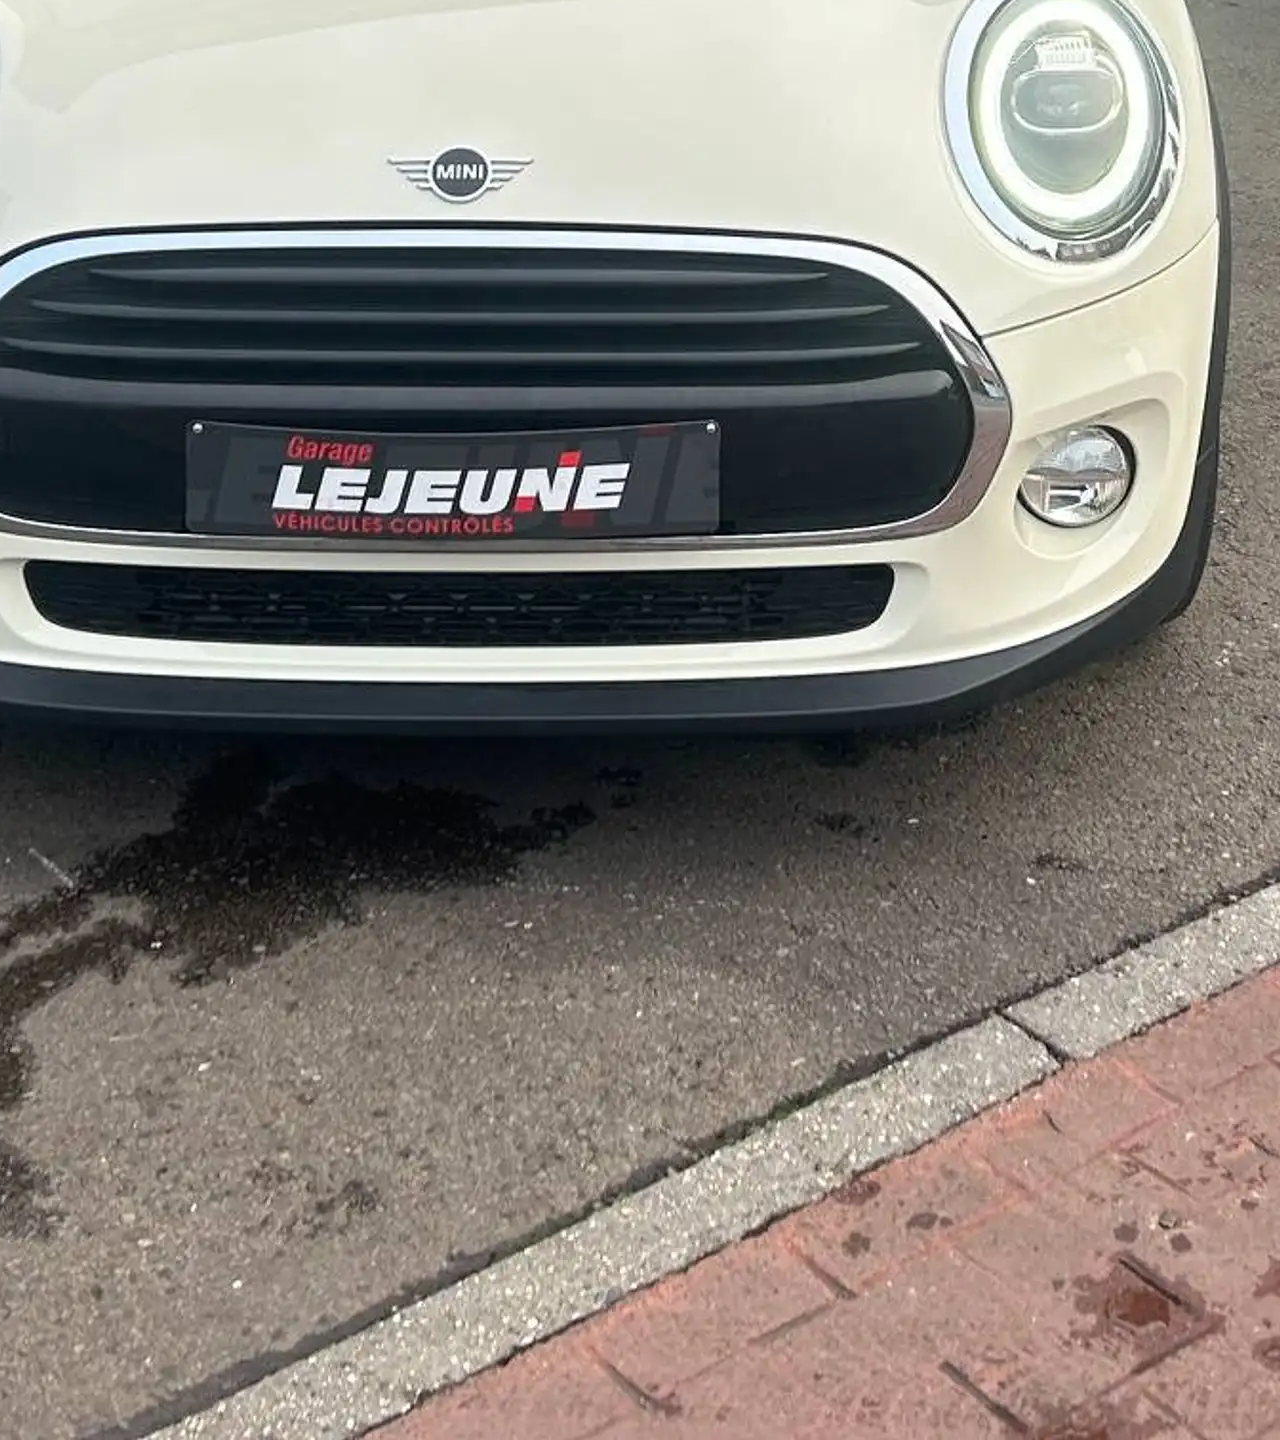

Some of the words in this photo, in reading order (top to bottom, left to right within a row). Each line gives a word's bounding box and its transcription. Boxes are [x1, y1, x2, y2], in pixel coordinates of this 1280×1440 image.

[436, 164, 484, 180] MINI
[287, 435, 375, 467] Garage
[272, 451, 630, 515] LEJEUNE
